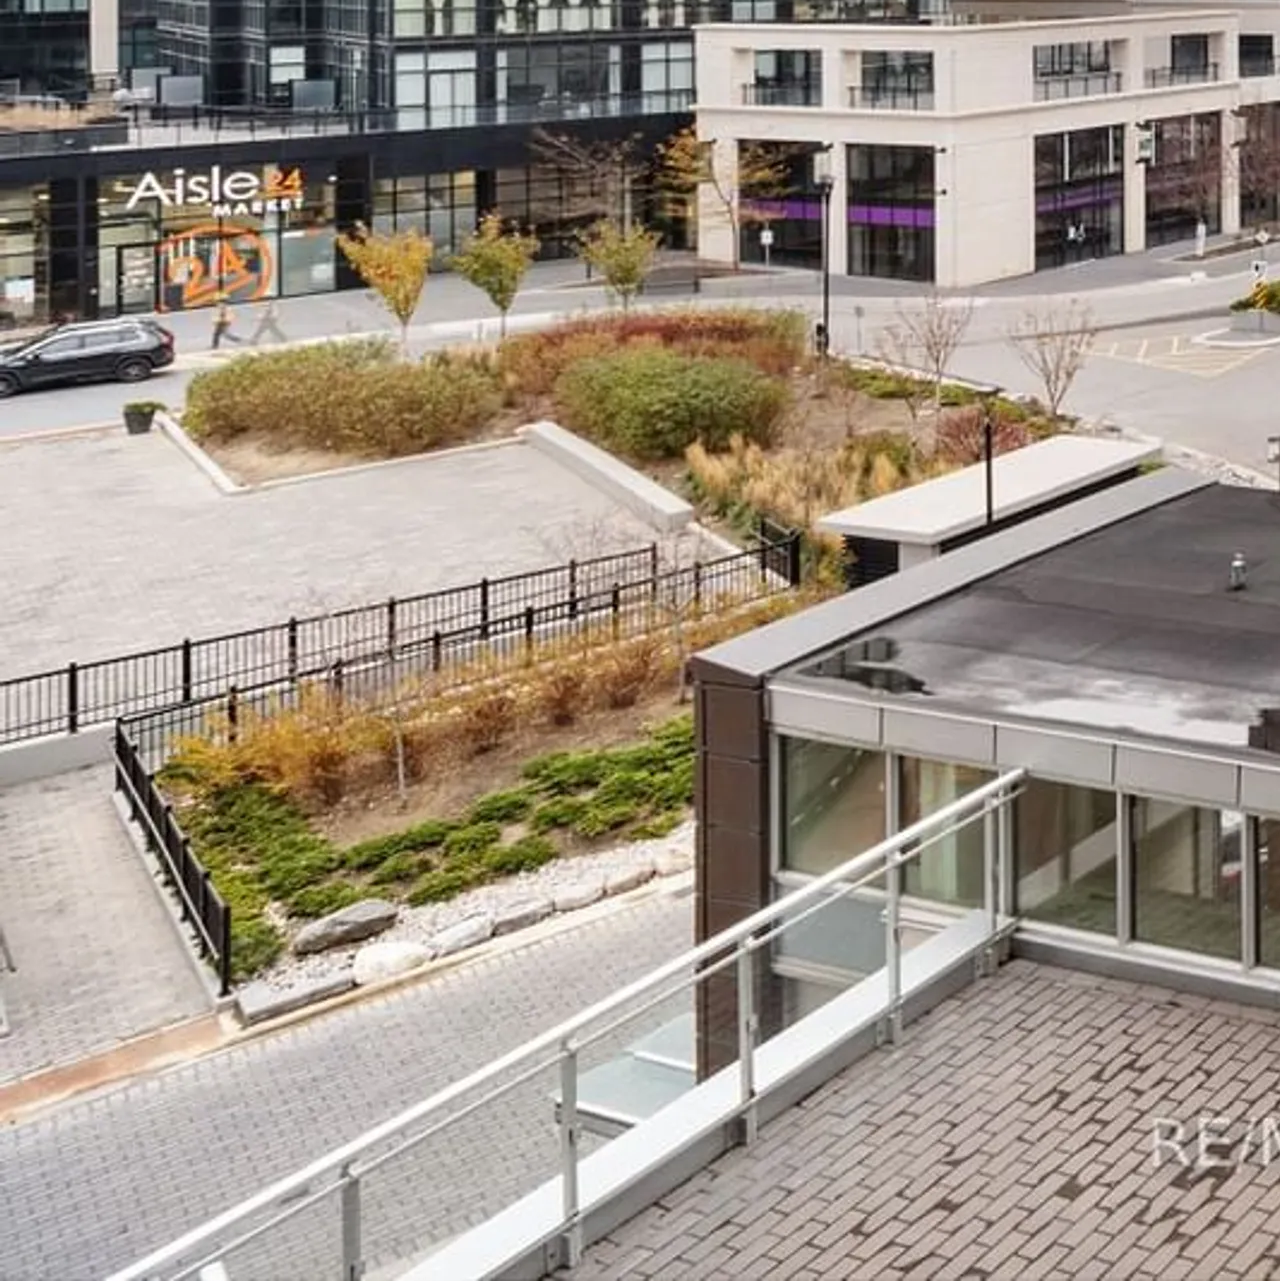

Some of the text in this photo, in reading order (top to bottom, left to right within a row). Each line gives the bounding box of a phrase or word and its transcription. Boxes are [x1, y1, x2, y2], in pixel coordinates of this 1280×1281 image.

[126, 165, 303, 209] Aisle 24
[212, 196, 303, 216] MARKET
